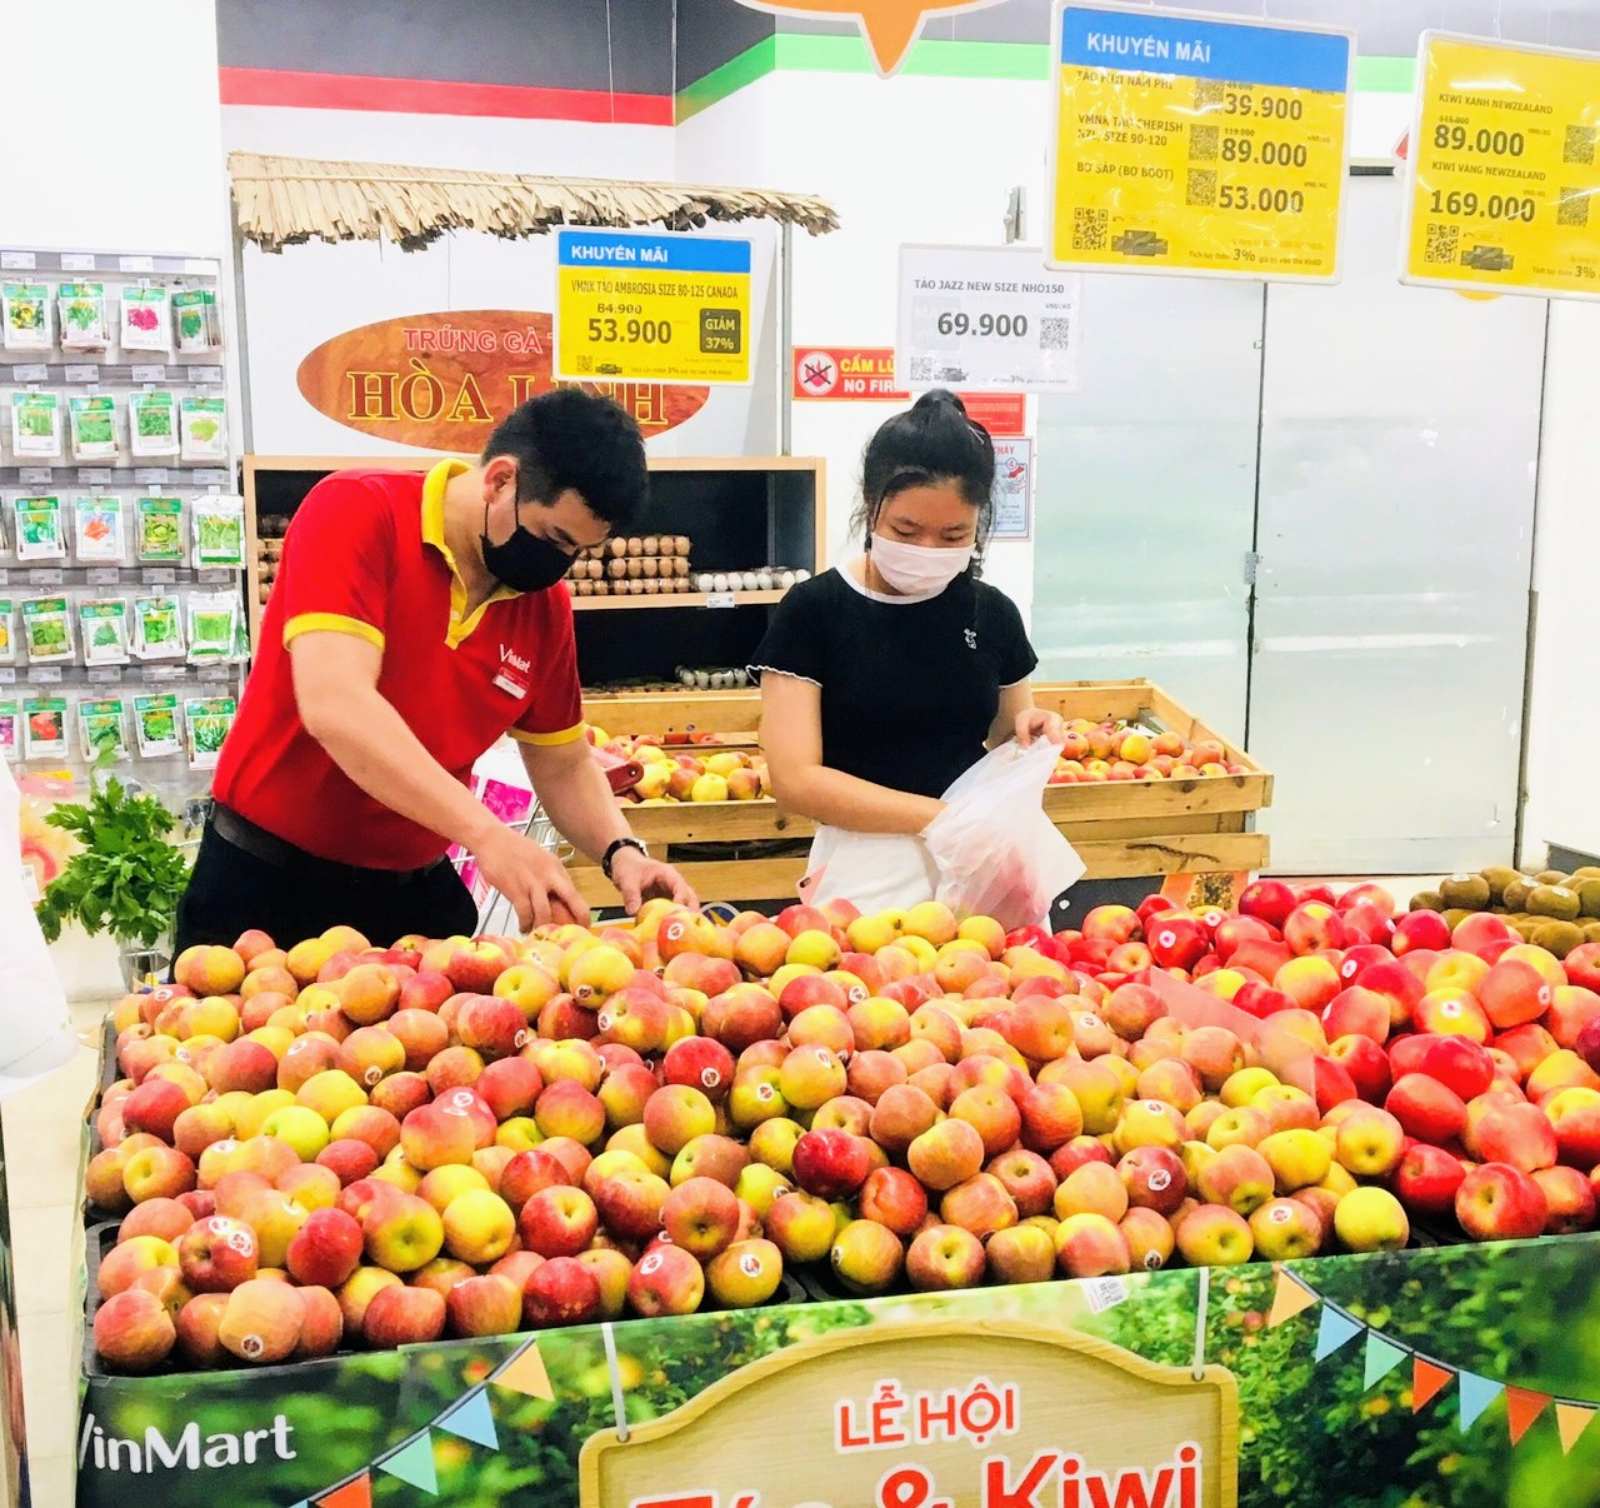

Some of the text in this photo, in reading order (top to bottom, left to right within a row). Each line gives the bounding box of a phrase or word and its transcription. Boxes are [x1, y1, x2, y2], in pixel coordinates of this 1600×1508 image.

[1224, 93, 1303, 120] 39.900
[1439, 93, 1462, 104] KIWI
[1221, 138, 1308, 168] 89.000
[1434, 124, 1525, 157] 89.000
[1432, 161, 1456, 172] KIWI
[1219, 185, 1305, 213] 53.000
[1430, 190, 1535, 223] 169.000
[1232, 248, 1256, 262] 3%
[614, 281, 657, 296] AMBROSIA
[658, 283, 676, 296] SIZE
[706, 285, 738, 298] CANADA
[938, 280, 964, 291] JAZZ
[966, 281, 992, 292] NEW
[994, 282, 1018, 293] SIZE
[588, 318, 673, 345] 53.900
[937, 312, 1029, 338] 69.900
[705, 337, 735, 350] 37%
[346, 358, 494, 424] HÒA
[844, 378, 895, 393] NO FIR
[839, 1383, 1014, 1447] LỄ HỘI
